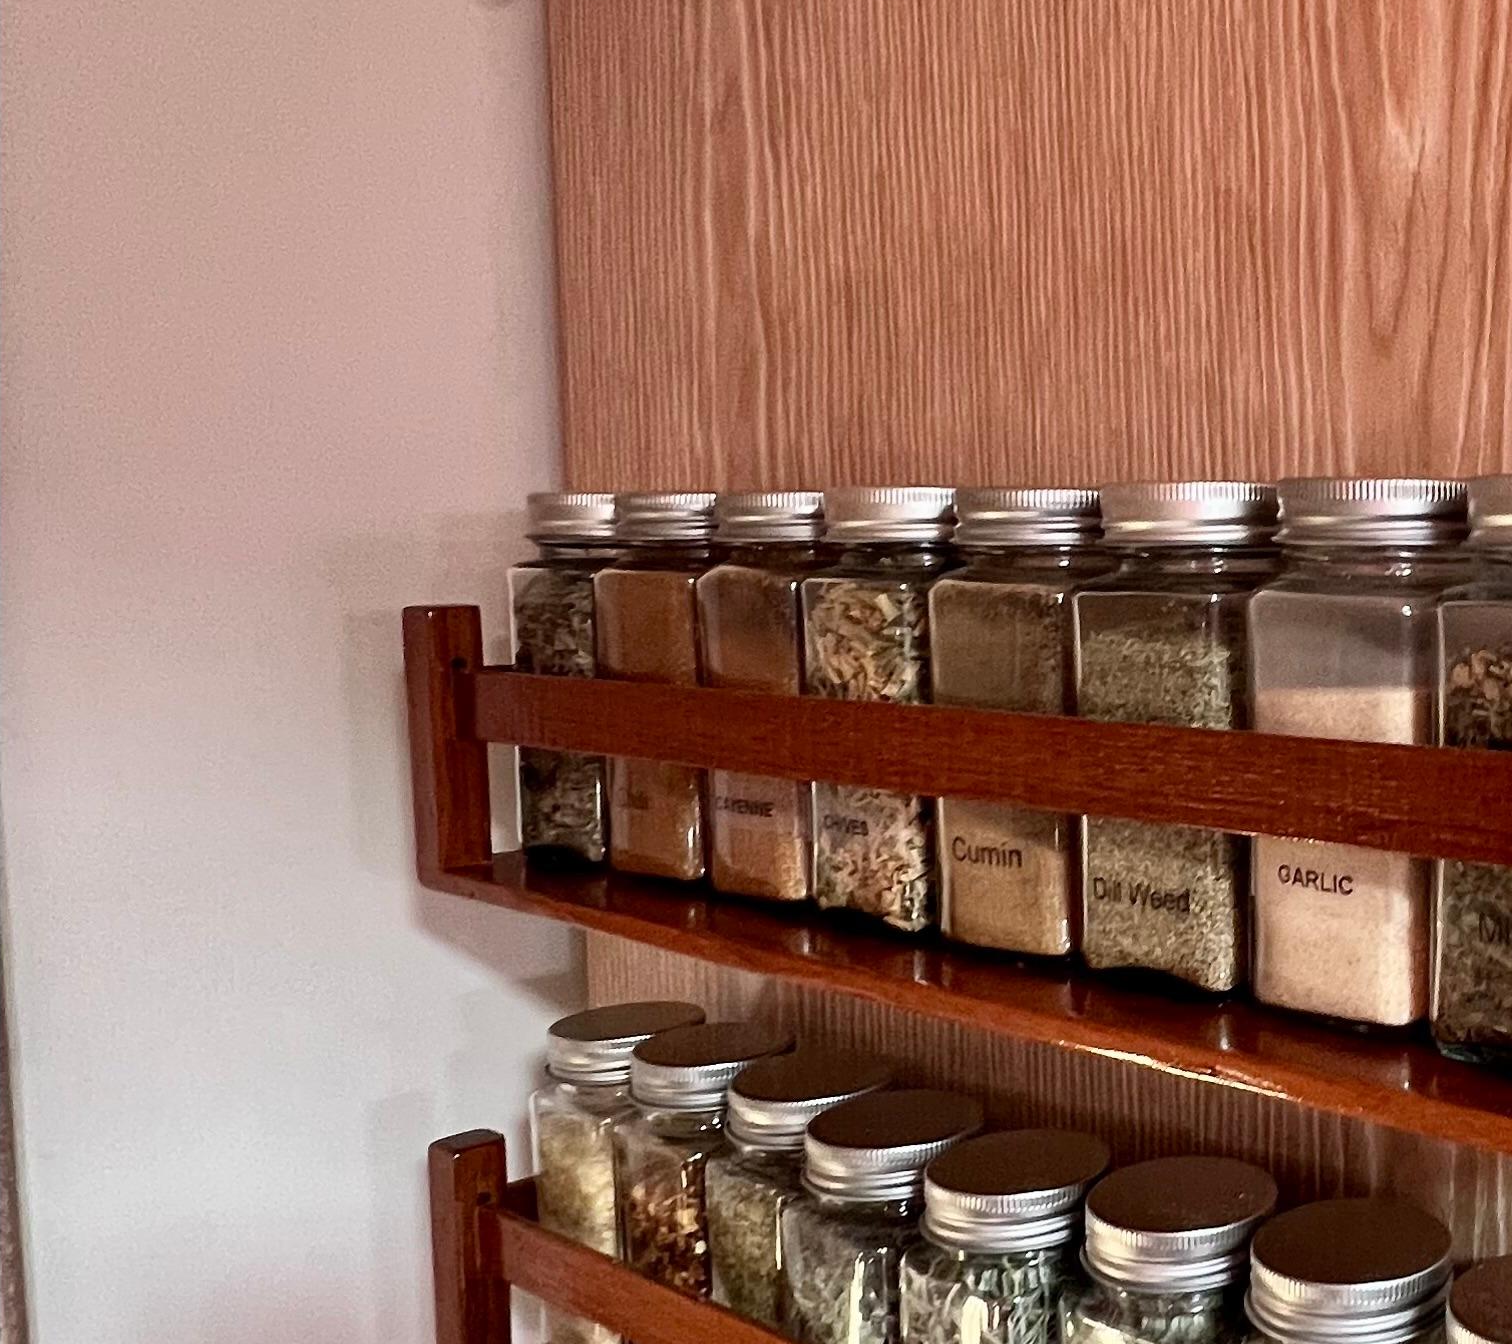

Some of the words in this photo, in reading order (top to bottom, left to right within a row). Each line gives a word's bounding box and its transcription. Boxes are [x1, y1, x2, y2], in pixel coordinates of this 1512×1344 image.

[952, 836, 1024, 869] Cumin
[1092, 876, 1123, 902] Dill
[1129, 882, 1191, 914] Weed
[1277, 864, 1355, 896] GARLIC
